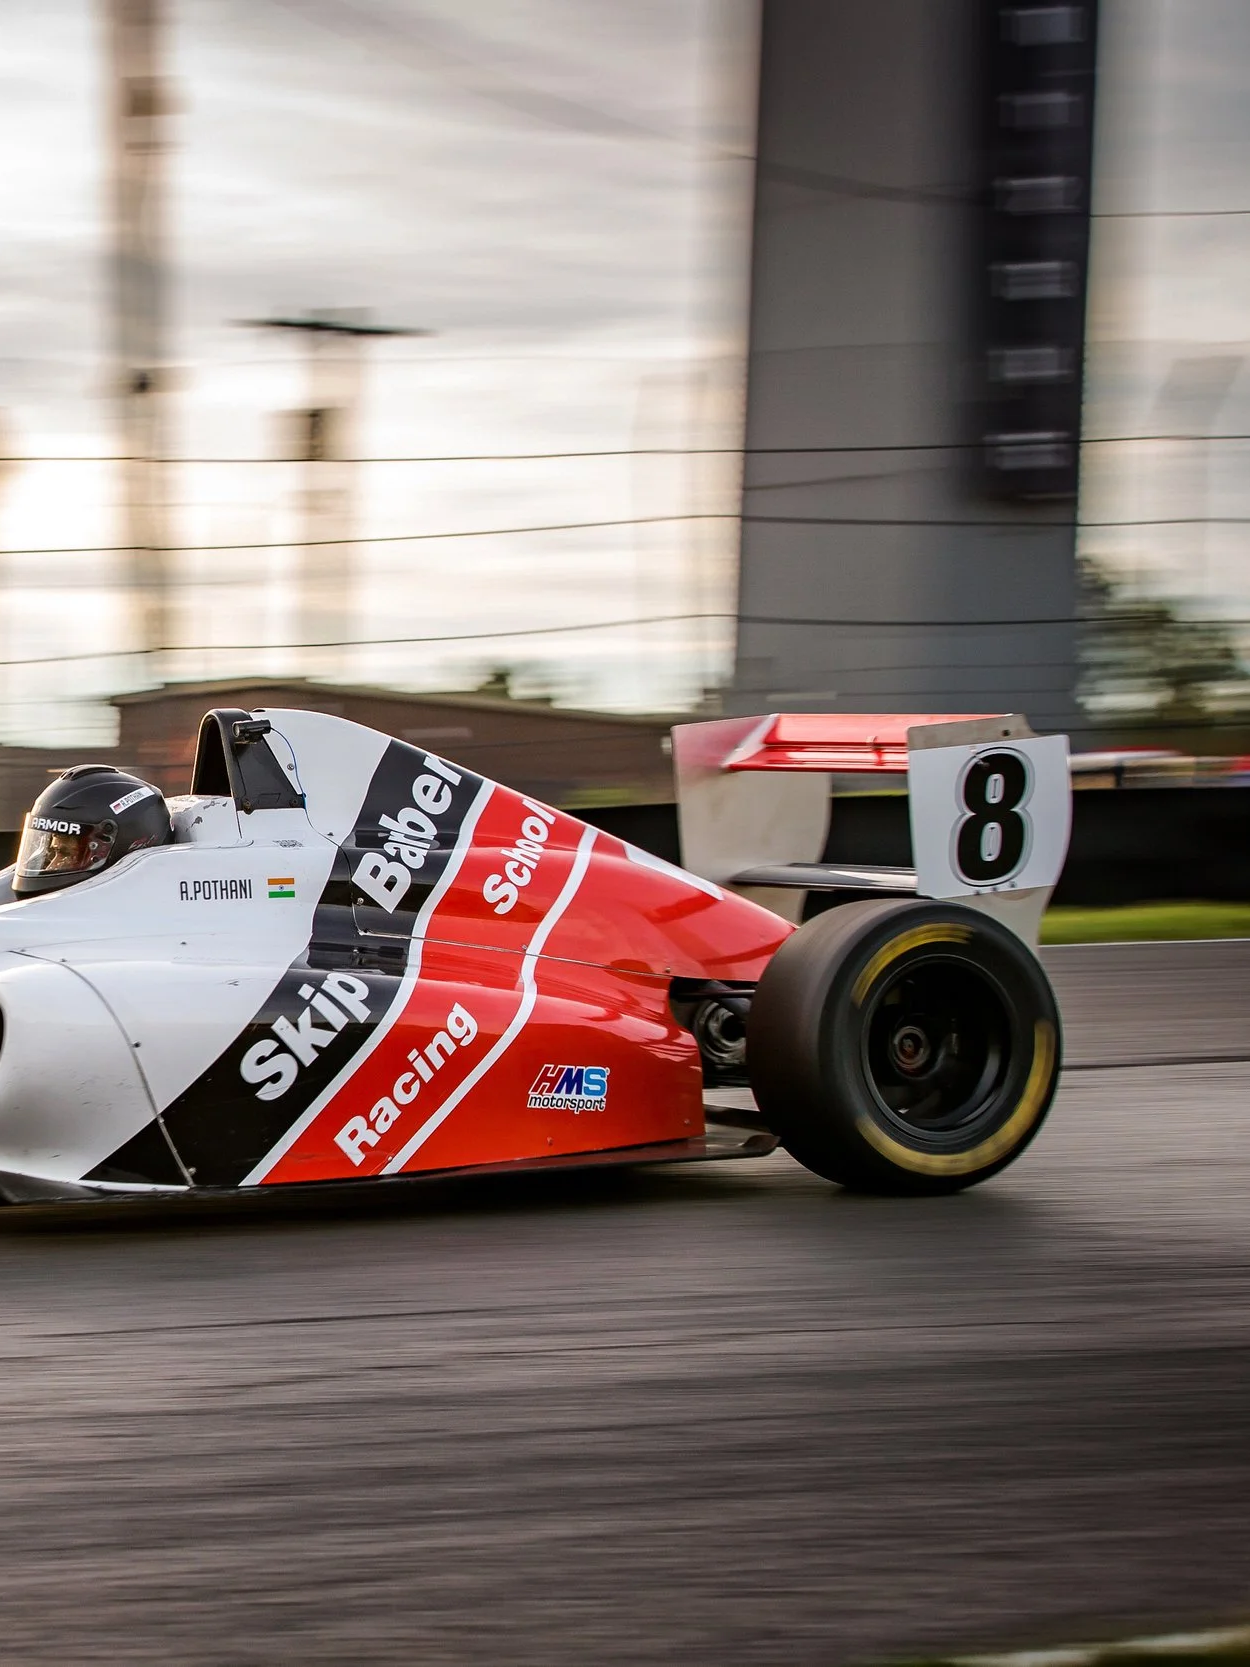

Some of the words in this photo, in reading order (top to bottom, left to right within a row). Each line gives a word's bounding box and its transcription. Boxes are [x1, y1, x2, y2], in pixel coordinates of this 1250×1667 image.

[31, 817, 81, 835] ARMOR
[952, 748, 1031, 884] 8
[180, 879, 252, 901] A.POTHANI
[240, 971, 371, 1101] Skip
[352, 754, 462, 914] Barber
[333, 1001, 478, 1167] Racing
[482, 799, 556, 915] School
[529, 1065, 607, 1095] HMS
[529, 1095, 605, 1113] motorsport
